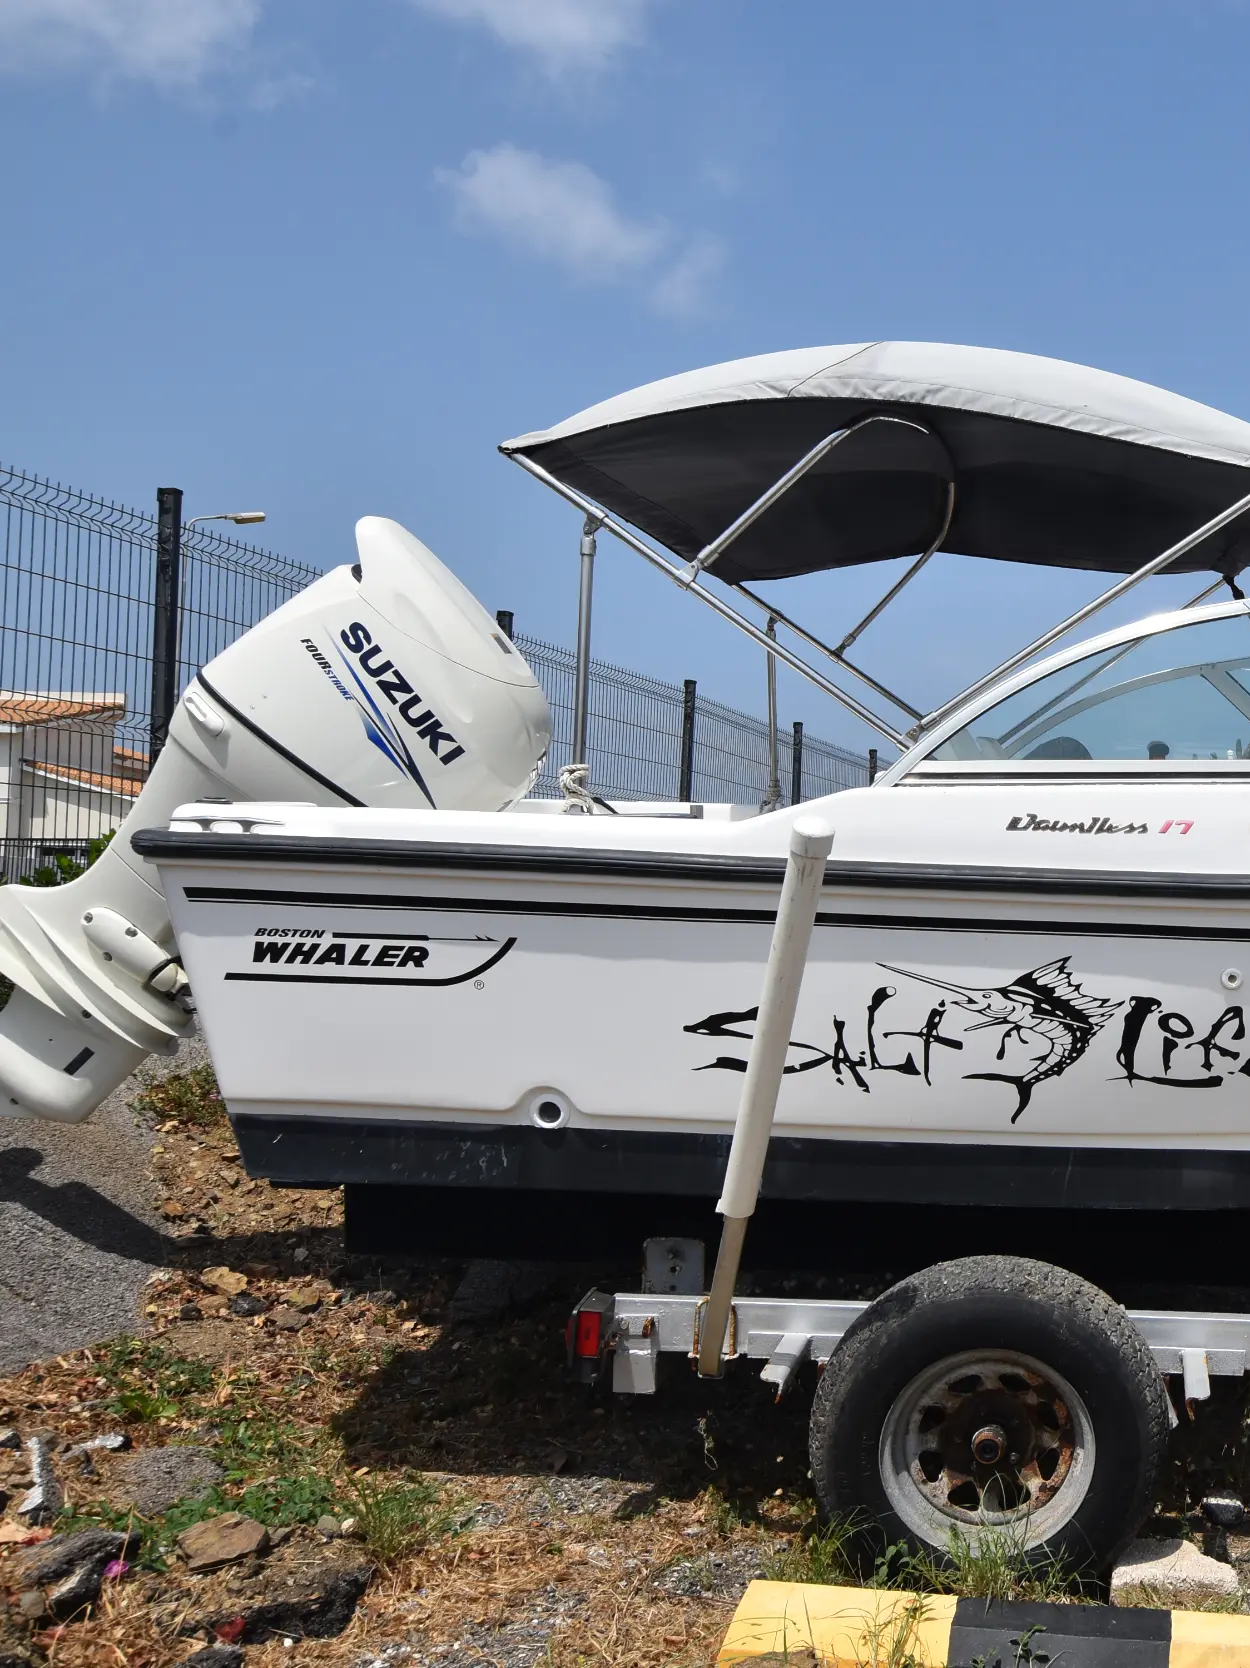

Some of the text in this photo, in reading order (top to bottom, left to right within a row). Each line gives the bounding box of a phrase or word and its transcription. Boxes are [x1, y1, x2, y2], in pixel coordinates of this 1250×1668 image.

[300, 638, 354, 701] FOURSTROKE
[340, 621, 466, 766] SUZUKI
[1005, 813, 1195, 836] Dauntless 17
[254, 927, 326, 939] BOSTON
[252, 941, 430, 968] WHALER
